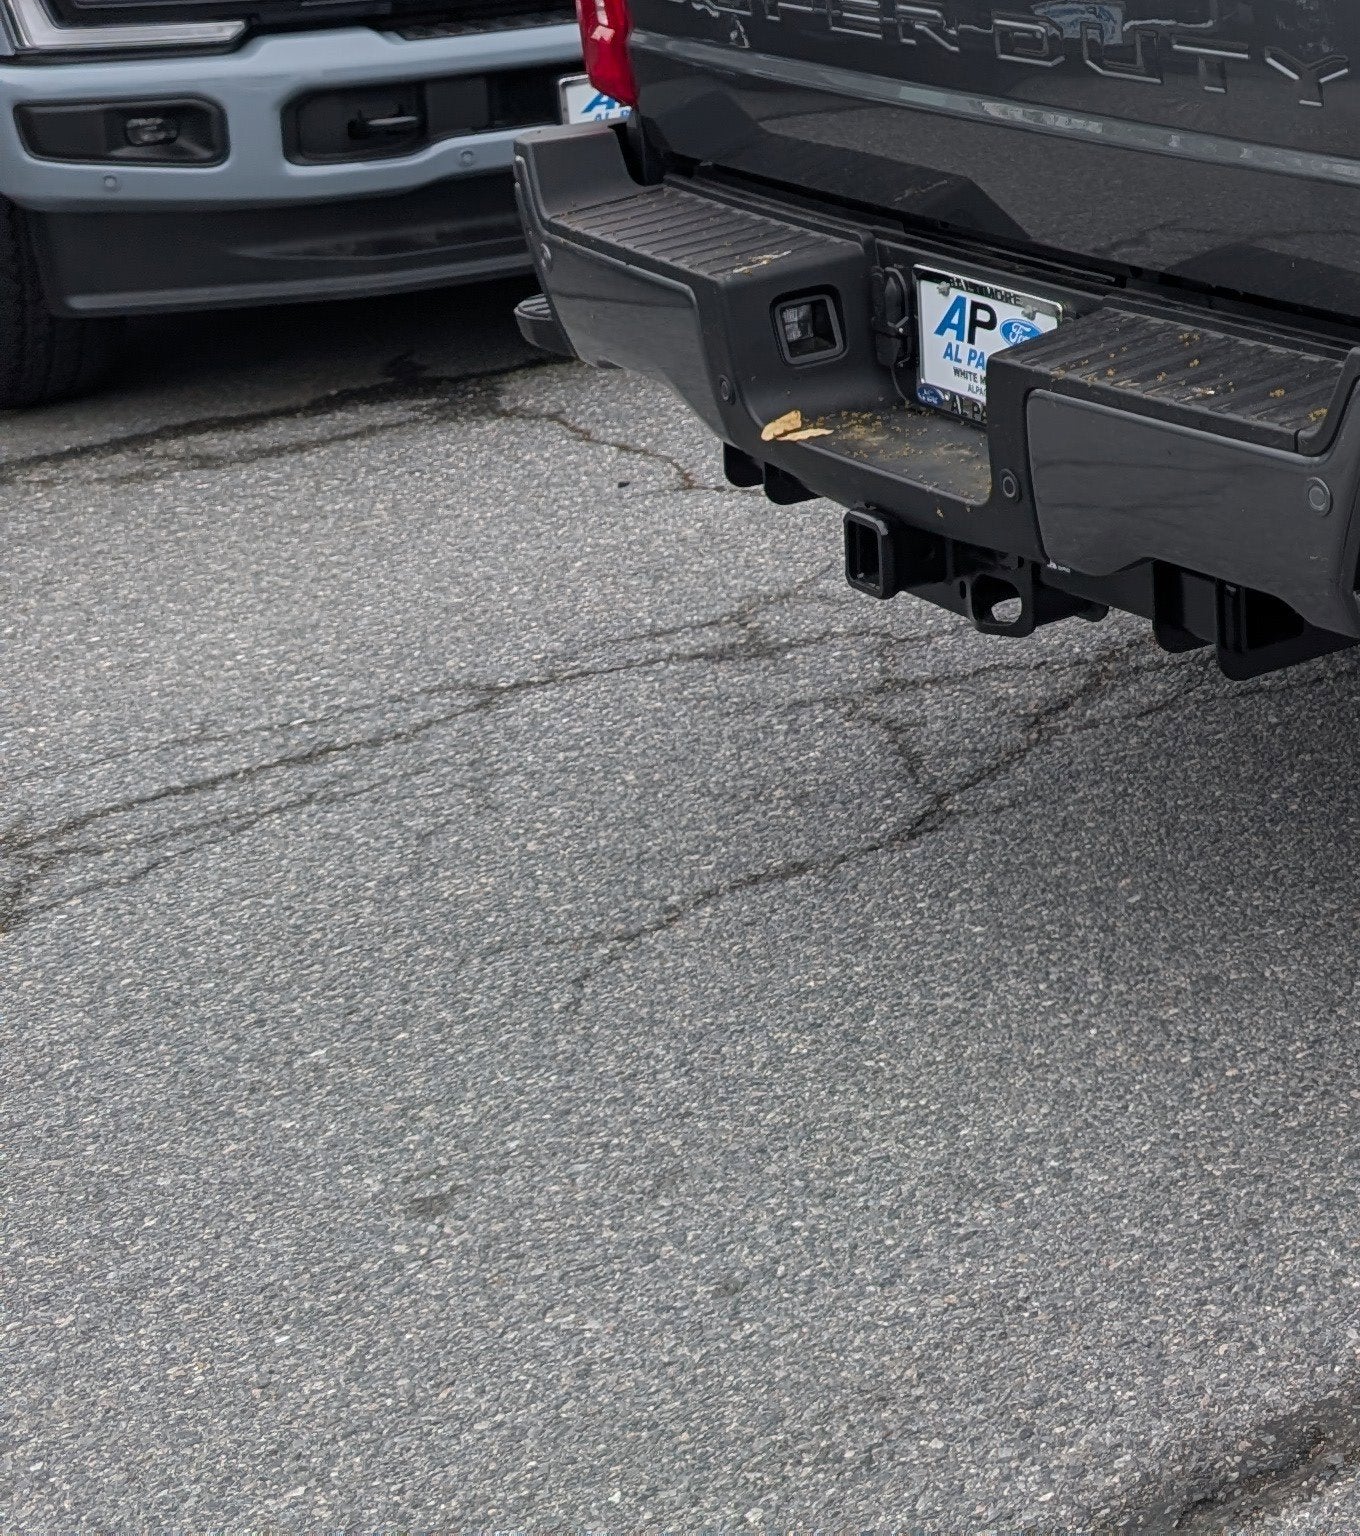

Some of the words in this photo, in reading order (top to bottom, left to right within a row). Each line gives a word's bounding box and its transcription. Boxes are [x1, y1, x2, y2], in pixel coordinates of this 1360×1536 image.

[991, 9, 1349, 107] DUTY
[934, 295, 998, 345] AP
[943, 342, 962, 364] AL
[953, 366, 978, 384] WHITE
